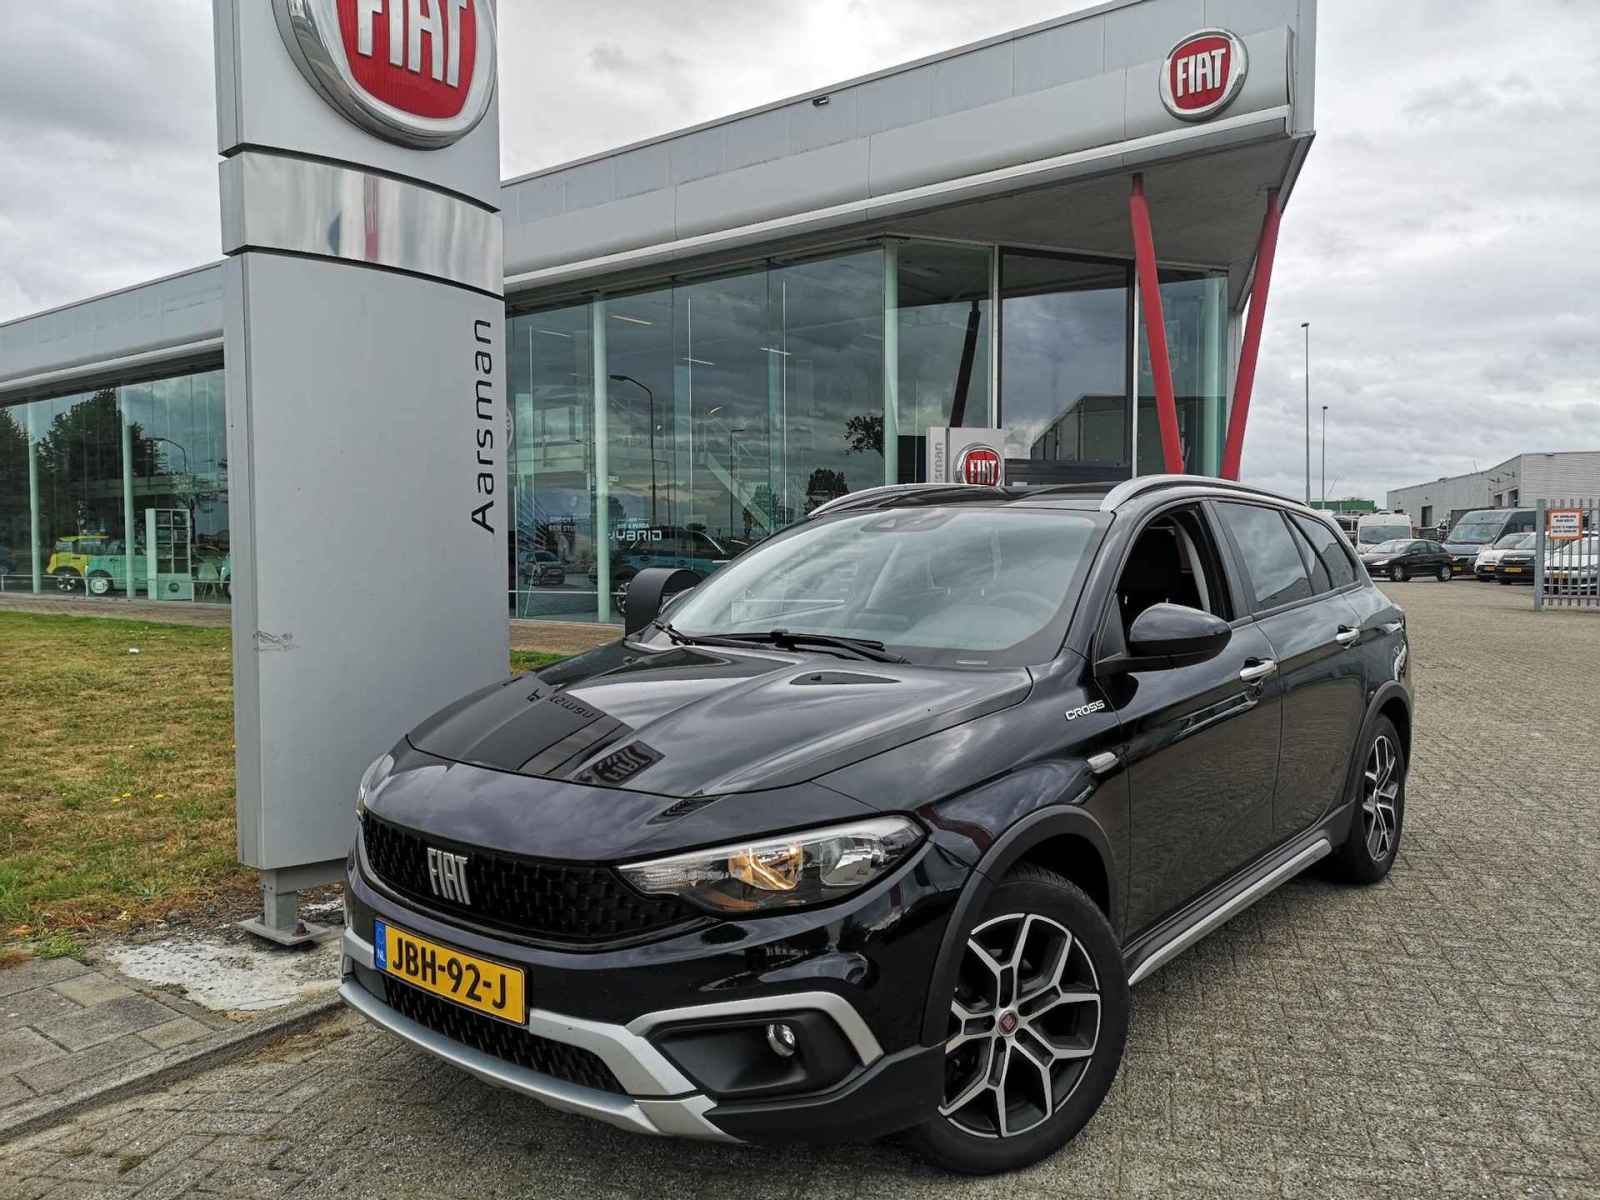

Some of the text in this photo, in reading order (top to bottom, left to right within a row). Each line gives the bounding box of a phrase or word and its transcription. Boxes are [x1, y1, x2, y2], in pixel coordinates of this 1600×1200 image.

[357, 0, 467, 88] FIAT
[1176, 47, 1227, 98] FIAT
[471, 319, 495, 535] Aarsman
[968, 459, 997, 484] FIAT
[1065, 699, 1105, 721] CROSS
[427, 847, 471, 905] FIAT
[376, 947, 386, 962] NL
[392, 937, 507, 1010] JBH-92-J
